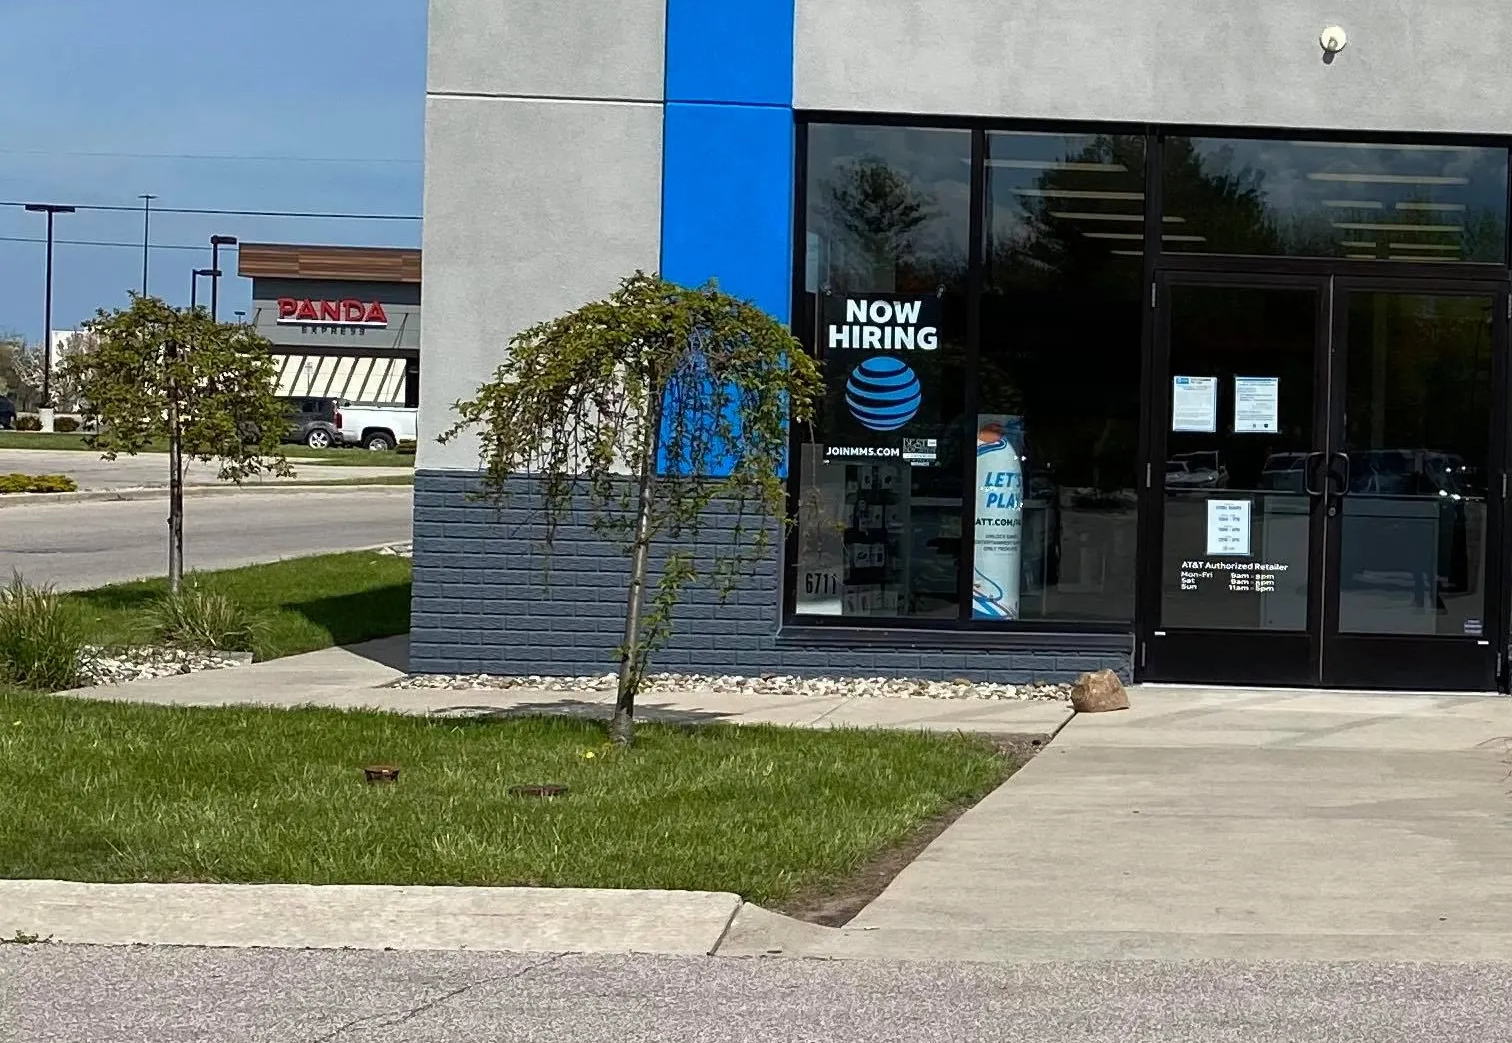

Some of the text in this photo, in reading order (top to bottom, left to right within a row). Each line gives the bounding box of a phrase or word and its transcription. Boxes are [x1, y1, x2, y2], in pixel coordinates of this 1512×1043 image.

[277, 297, 387, 322] PANDA
[846, 299, 922, 324] NOW
[301, 325, 366, 336] EXPRESS
[828, 324, 938, 350] HIRING
[1181, 561, 1288, 571] AT&T Authorized Retailer
[805, 572, 837, 595] 6711
